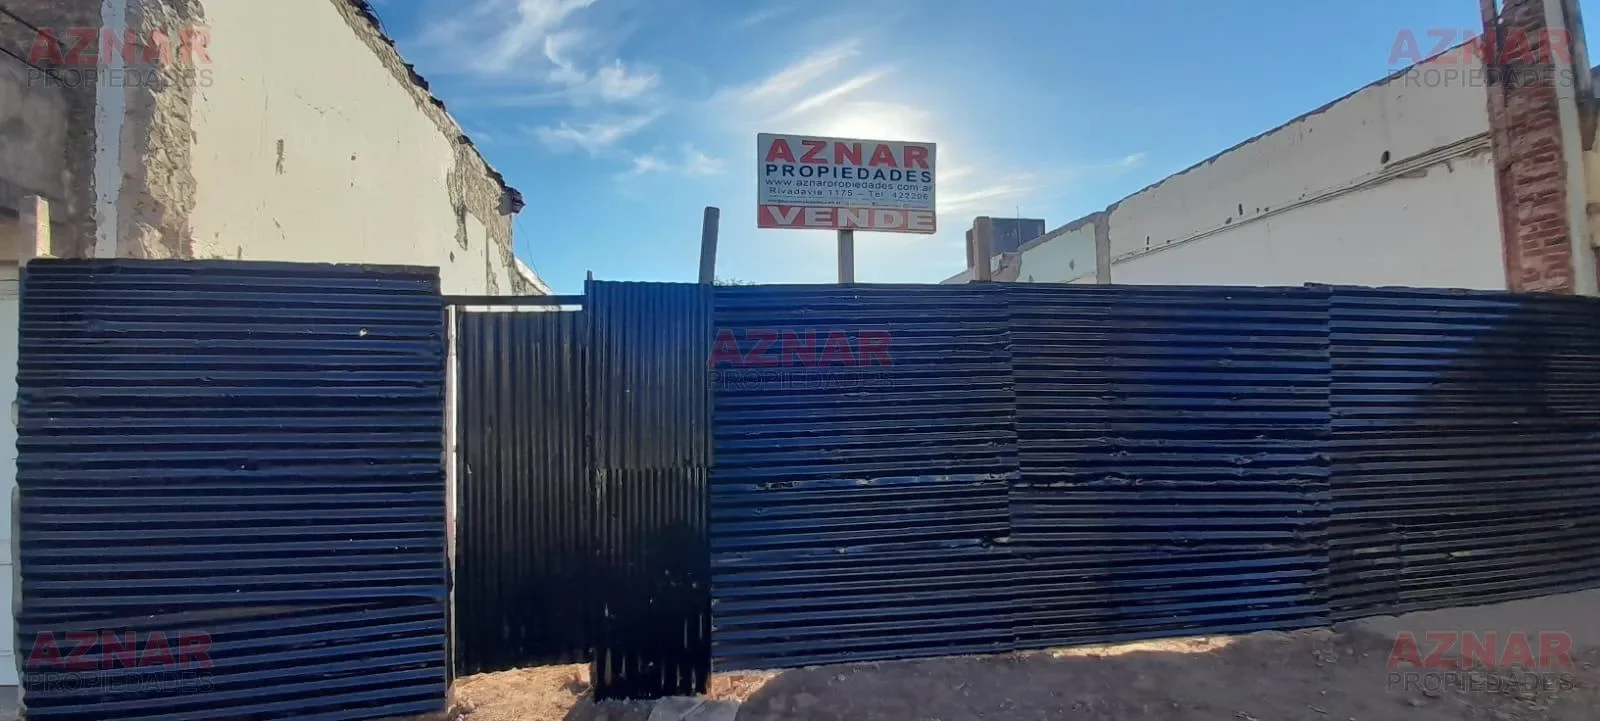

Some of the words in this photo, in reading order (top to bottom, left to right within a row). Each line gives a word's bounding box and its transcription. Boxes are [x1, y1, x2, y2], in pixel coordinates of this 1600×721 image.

[765, 138, 930, 169] AZNAR
[765, 164, 931, 183] PROPIEDADES
[769, 187, 823, 196] Rivadavia
[828, 189, 853, 197] 1175
[766, 205, 936, 232] VENDE
